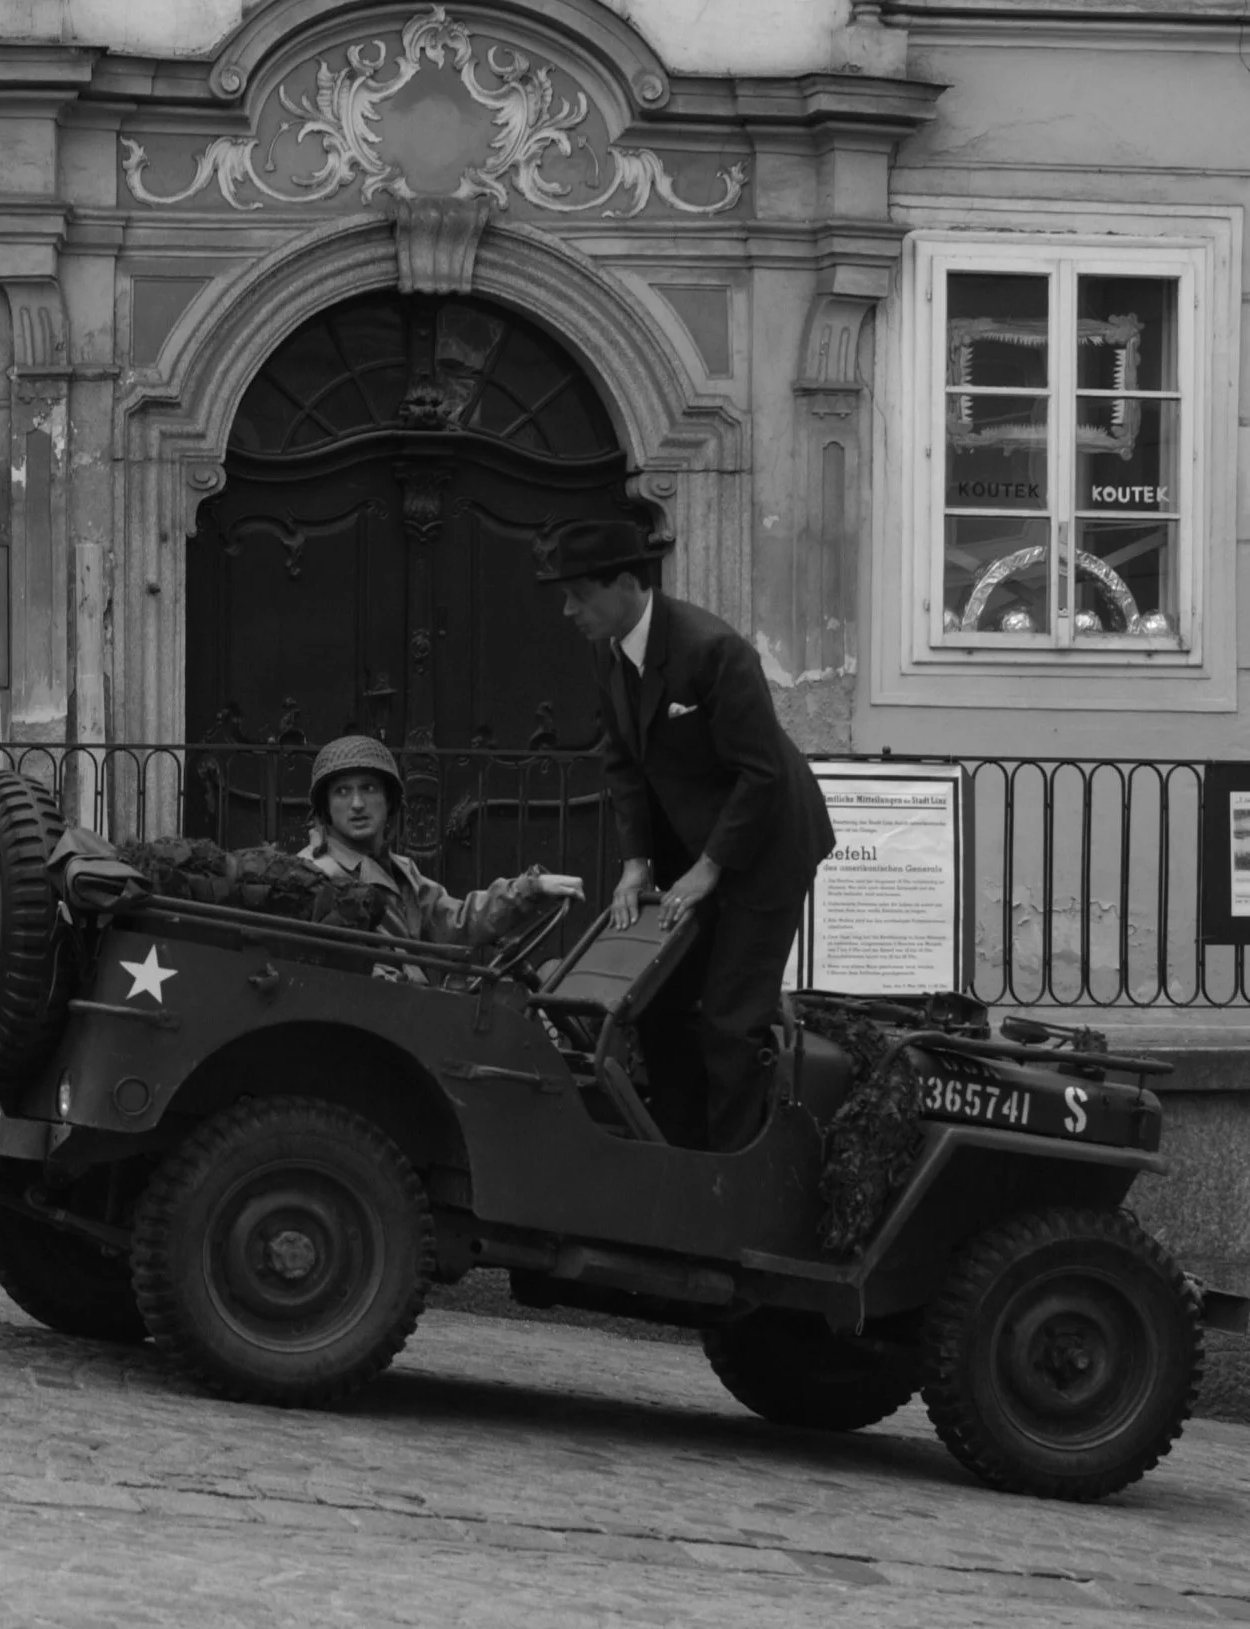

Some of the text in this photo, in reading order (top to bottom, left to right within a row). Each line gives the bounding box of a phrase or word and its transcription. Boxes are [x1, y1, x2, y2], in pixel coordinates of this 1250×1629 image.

[958, 481, 1040, 499] KOUTEK
[1092, 485, 1170, 503] KOUTEK
[823, 795, 854, 804] mtliche
[912, 796, 930, 804] Stadt
[931, 796, 947, 805] Linz
[823, 864, 837, 872] des
[905, 864, 943, 873] Generals
[1063, 1086, 1088, 1133] S
